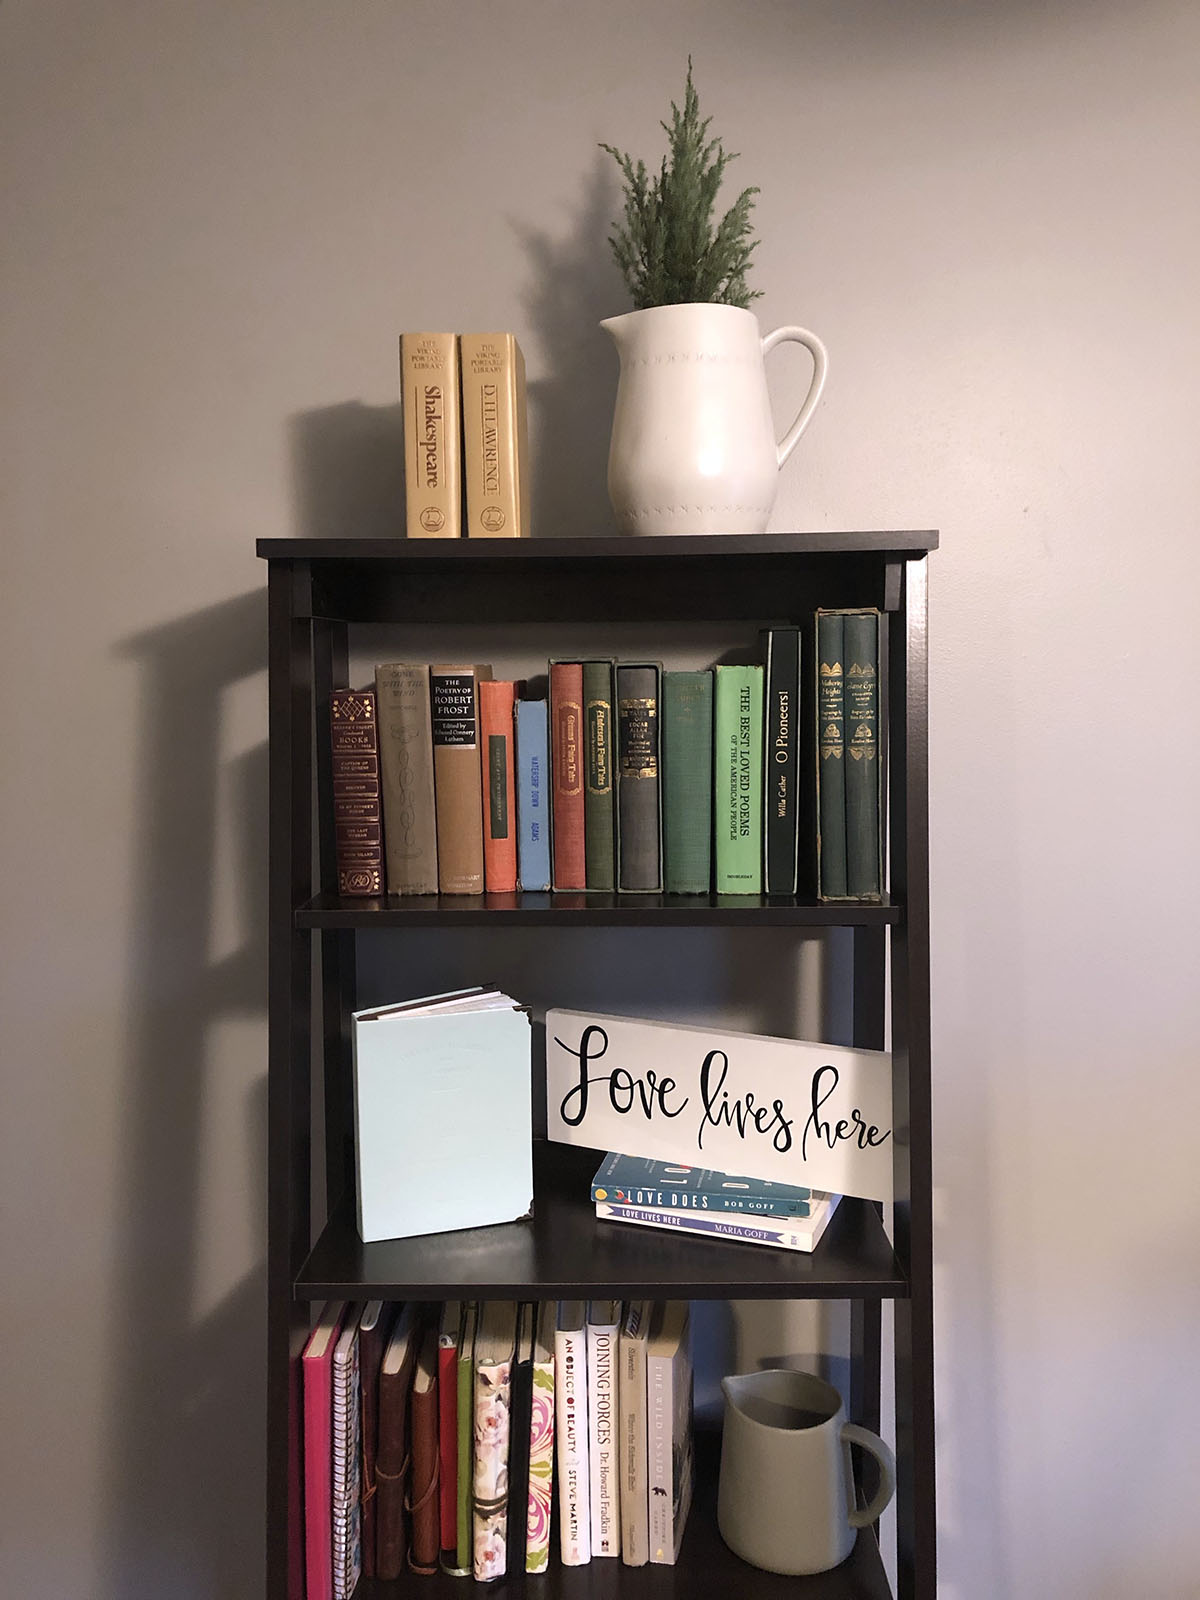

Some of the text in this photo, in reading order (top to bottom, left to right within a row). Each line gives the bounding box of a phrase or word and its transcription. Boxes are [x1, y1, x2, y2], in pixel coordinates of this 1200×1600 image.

[420, 385, 442, 489] Shakespeare
[485, 417, 498, 496] LAWRENCE
[435, 696, 473, 704] ROBERT
[823, 688, 841, 697] Heights
[438, 706, 469, 714] FROST
[775, 691, 789, 764] O Pioneers!
[730, 734, 738, 744] OF
[568, 744, 576, 763] Fairy
[597, 747, 606, 766] Fairy
[740, 686, 750, 837] THE BEST LOVED POEMS
[568, 764, 577, 783] Tales
[598, 766, 606, 786] Tales
[730, 766, 738, 808] AMERICAN
[778, 776, 787, 818] Willa Cather
[554, 1025, 891, 1162] Love lives here
[627, 1190, 709, 1209] LOVE DOES
[724, 1200, 775, 1210] BOB GOFF
[622, 1209, 681, 1226] LOVE LIVES HERE
[715, 1224, 769, 1240] MARIA GOFF
[565, 1339, 573, 1353] AN
[566, 1356, 575, 1395] OBJECT
[594, 1332, 611, 1445] JOINING FORCES
[566, 1397, 575, 1411] OF
[567, 1414, 576, 1453] BEAUTY
[600, 1452, 609, 1465] Dr.
[568, 1470, 577, 1500] STEVE
[600, 1466, 610, 1499] Howard
[570, 1504, 578, 1541] MARTIN
[600, 1502, 610, 1535] Fradkin
